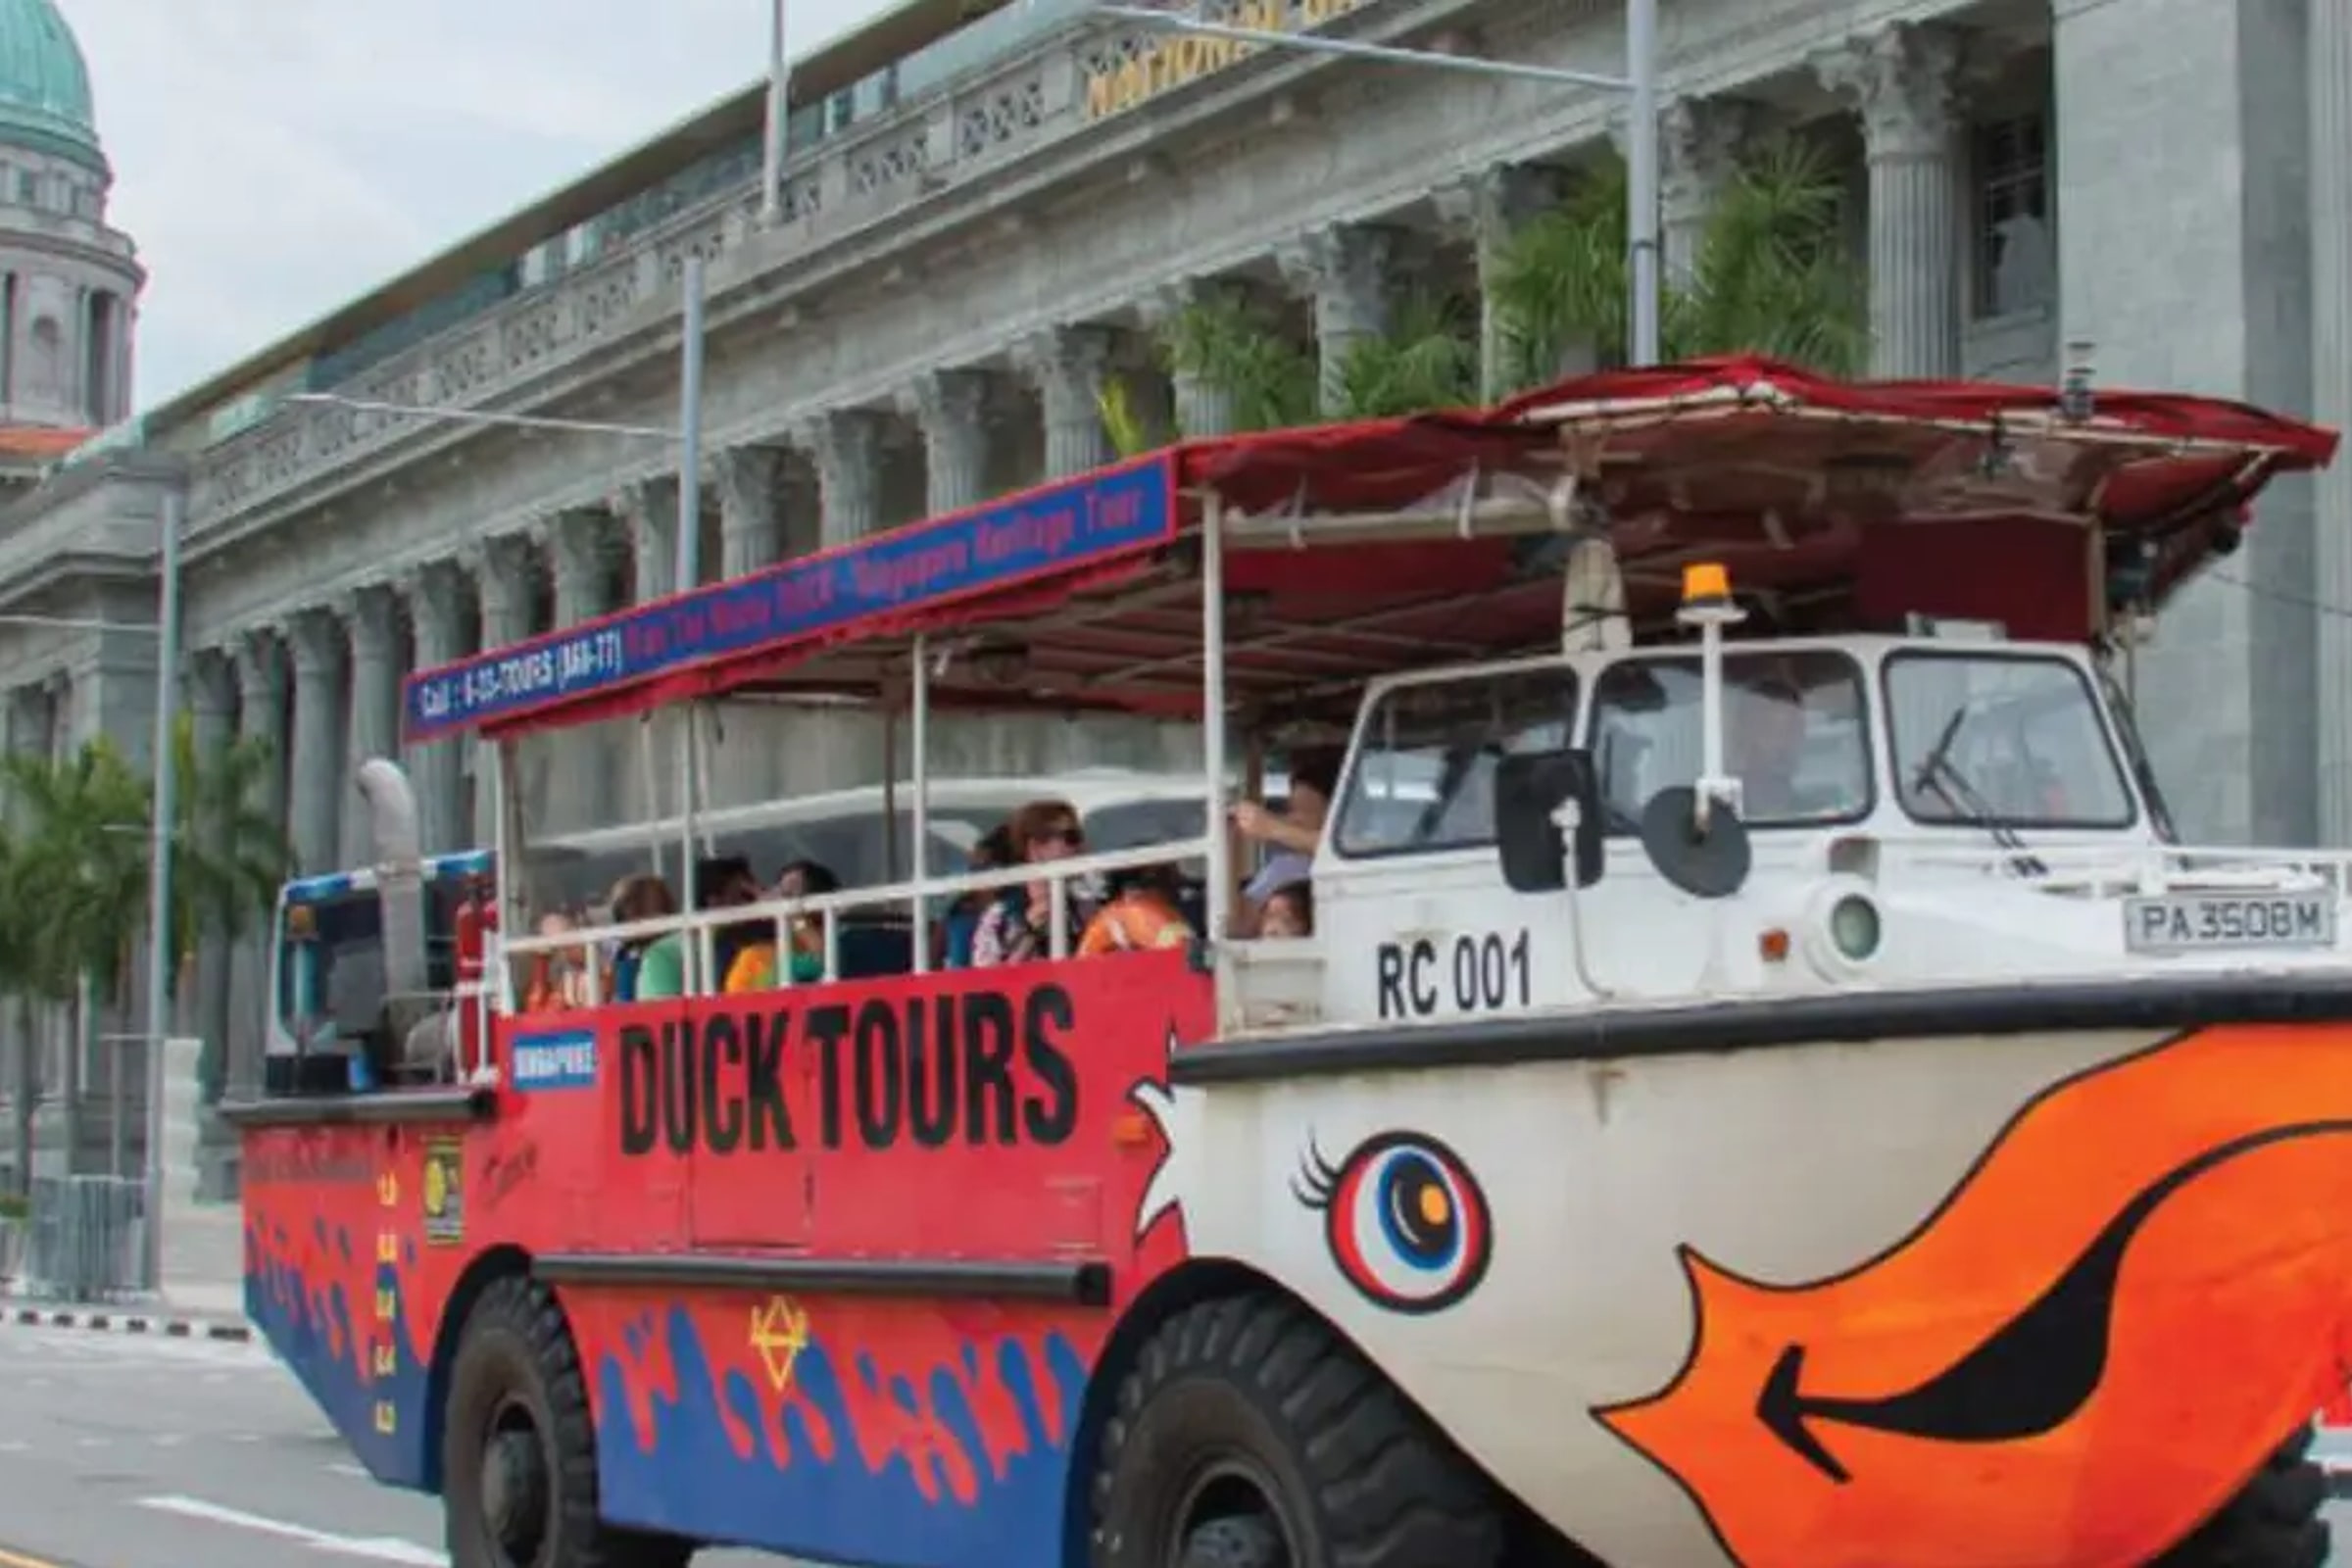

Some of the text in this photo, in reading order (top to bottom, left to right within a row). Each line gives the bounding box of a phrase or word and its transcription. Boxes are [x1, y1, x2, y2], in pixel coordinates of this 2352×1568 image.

[1378, 927, 1531, 1019] RC 001
[618, 981, 1078, 1156] DUCK TOURS
